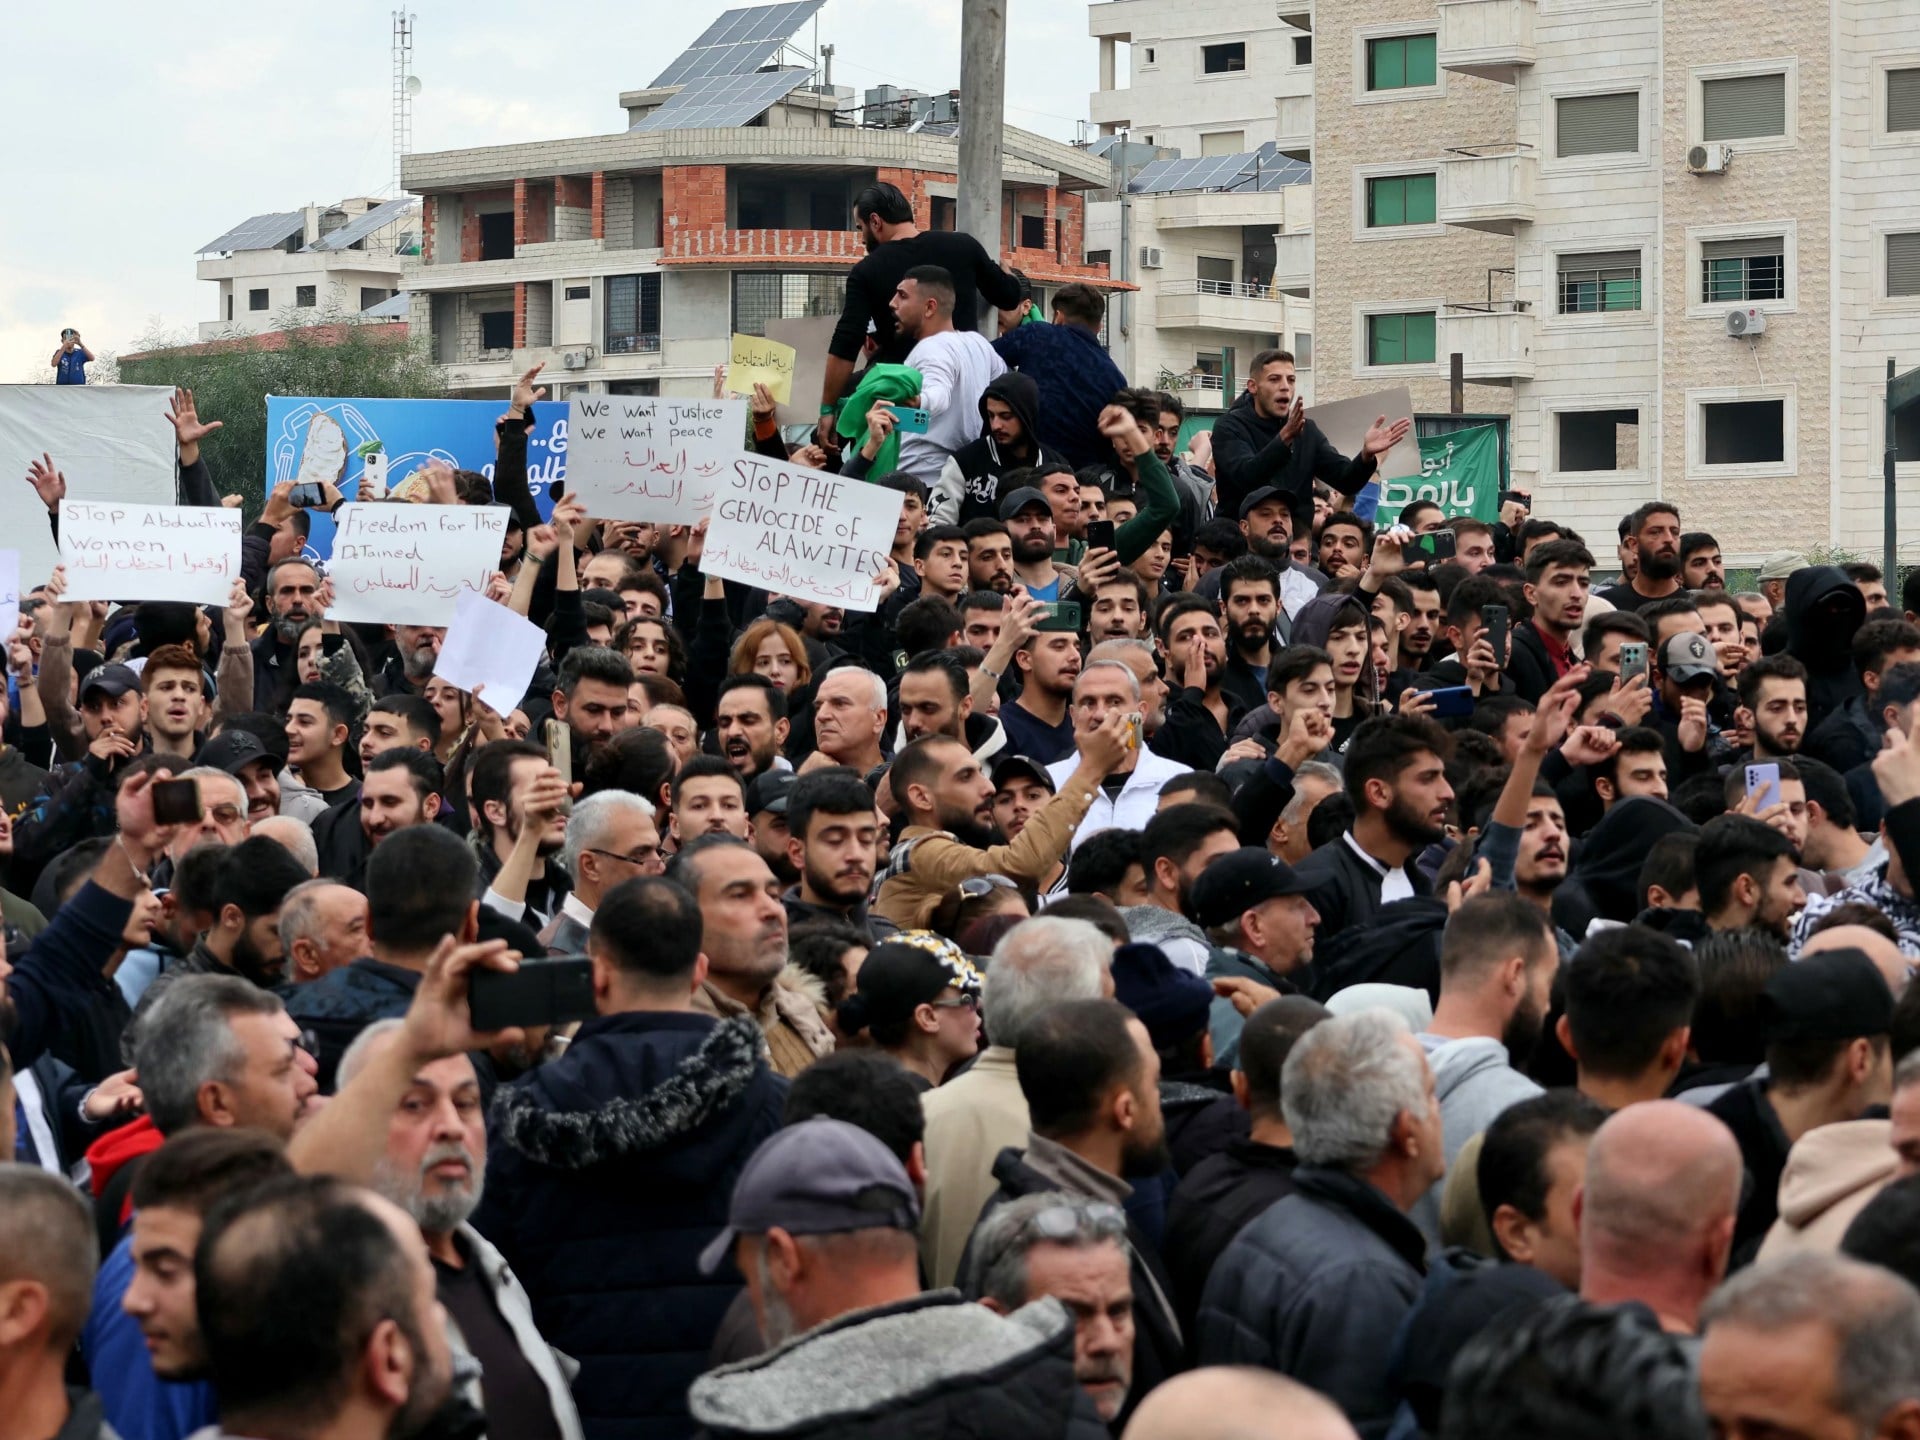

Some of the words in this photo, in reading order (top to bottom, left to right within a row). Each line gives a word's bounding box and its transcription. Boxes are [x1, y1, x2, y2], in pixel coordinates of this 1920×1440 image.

[580, 400, 610, 418] We
[668, 402, 724, 425] Justice
[669, 426, 713, 447] peace
[622, 448, 686, 475] العدالة
[611, 478, 683, 507] السلام
[797, 474, 846, 513] THE
[1378, 480, 1475, 514] بالمط
[345, 508, 427, 536] Freedom
[719, 499, 825, 536] GENOCIDE
[756, 531, 883, 579] ALAWITES
